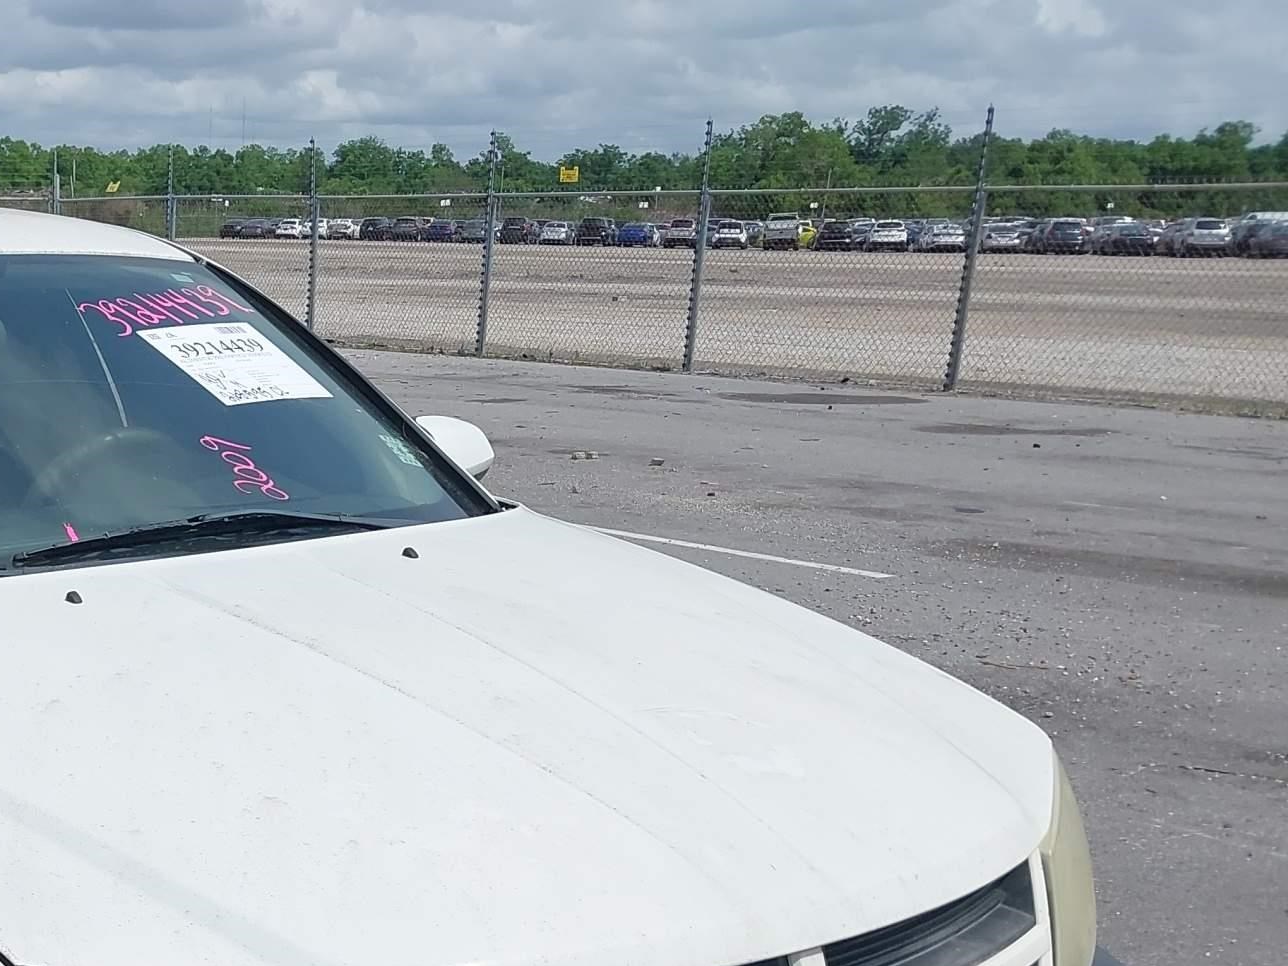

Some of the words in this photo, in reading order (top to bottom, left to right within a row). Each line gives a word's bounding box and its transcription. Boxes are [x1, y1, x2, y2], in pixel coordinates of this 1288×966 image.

[77, 284, 256, 337] 39214439
[171, 337, 264, 359] 39214439
[199, 435, 290, 501] 2009
